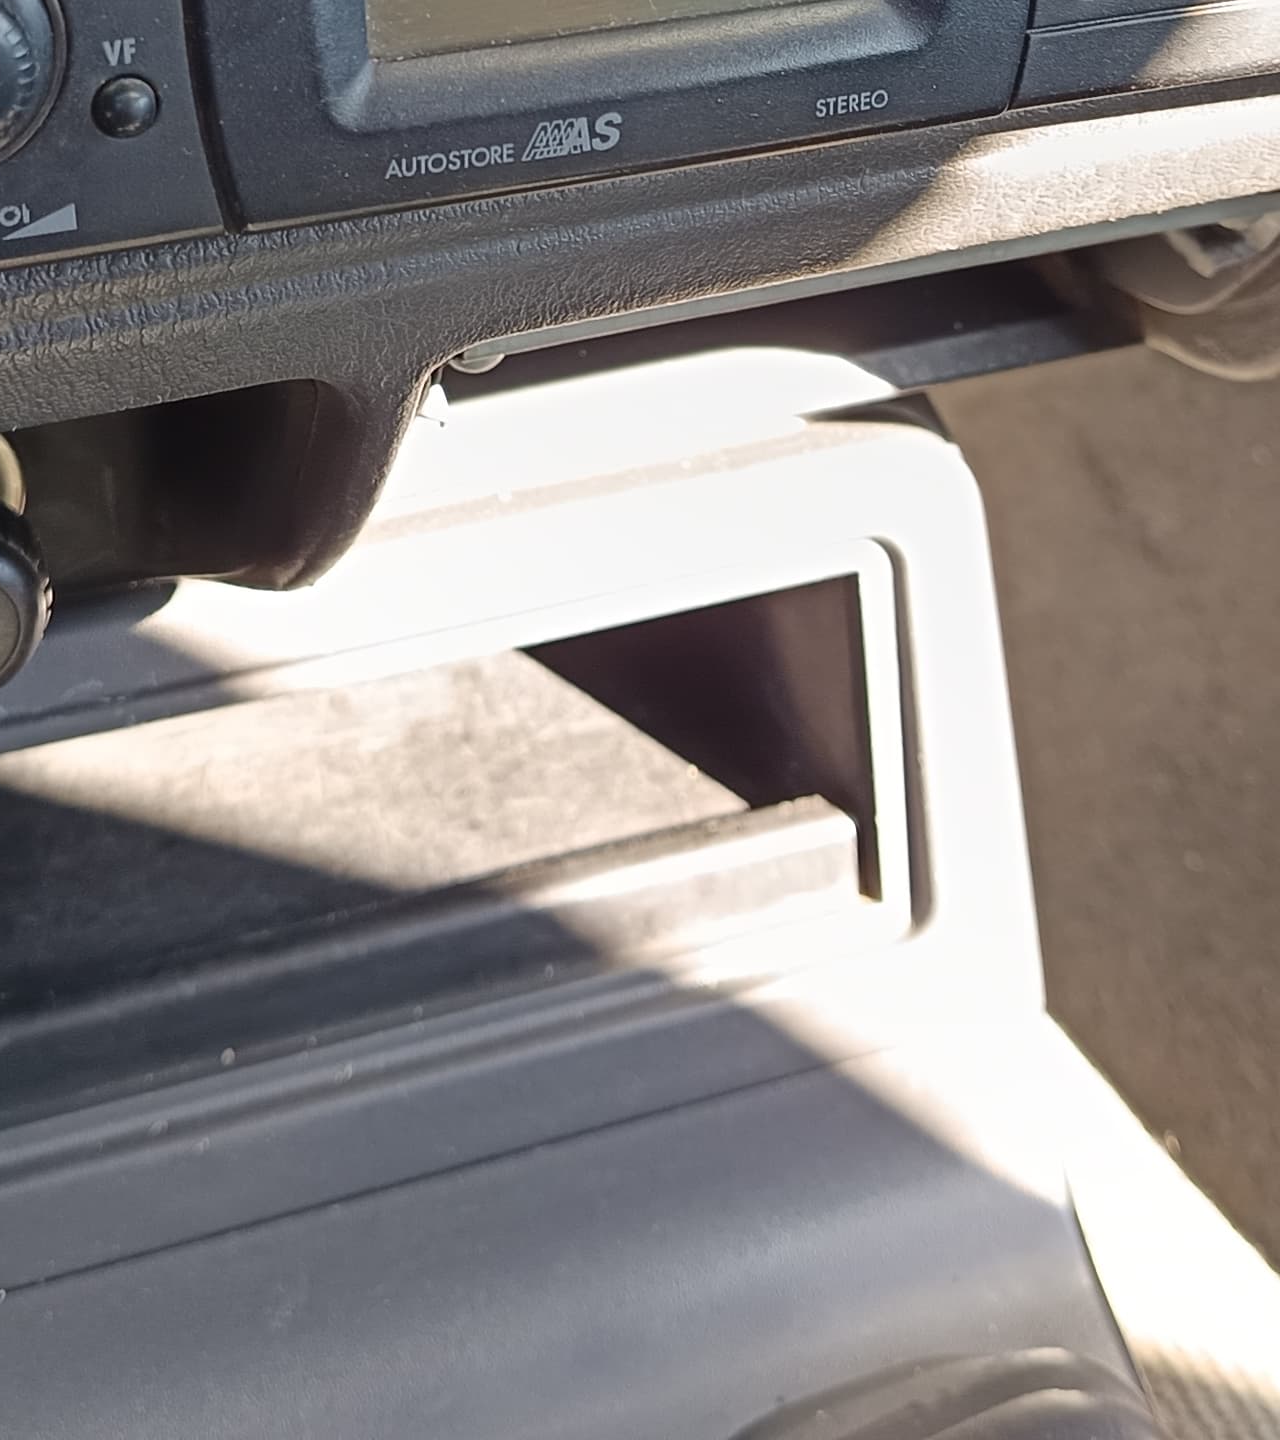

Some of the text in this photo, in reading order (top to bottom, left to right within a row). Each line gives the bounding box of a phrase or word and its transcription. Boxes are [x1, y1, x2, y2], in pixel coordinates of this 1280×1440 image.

[103, 38, 136, 65] VF
[815, 89, 889, 118] STEREO
[385, 143, 515, 180] AUTOSTORE
